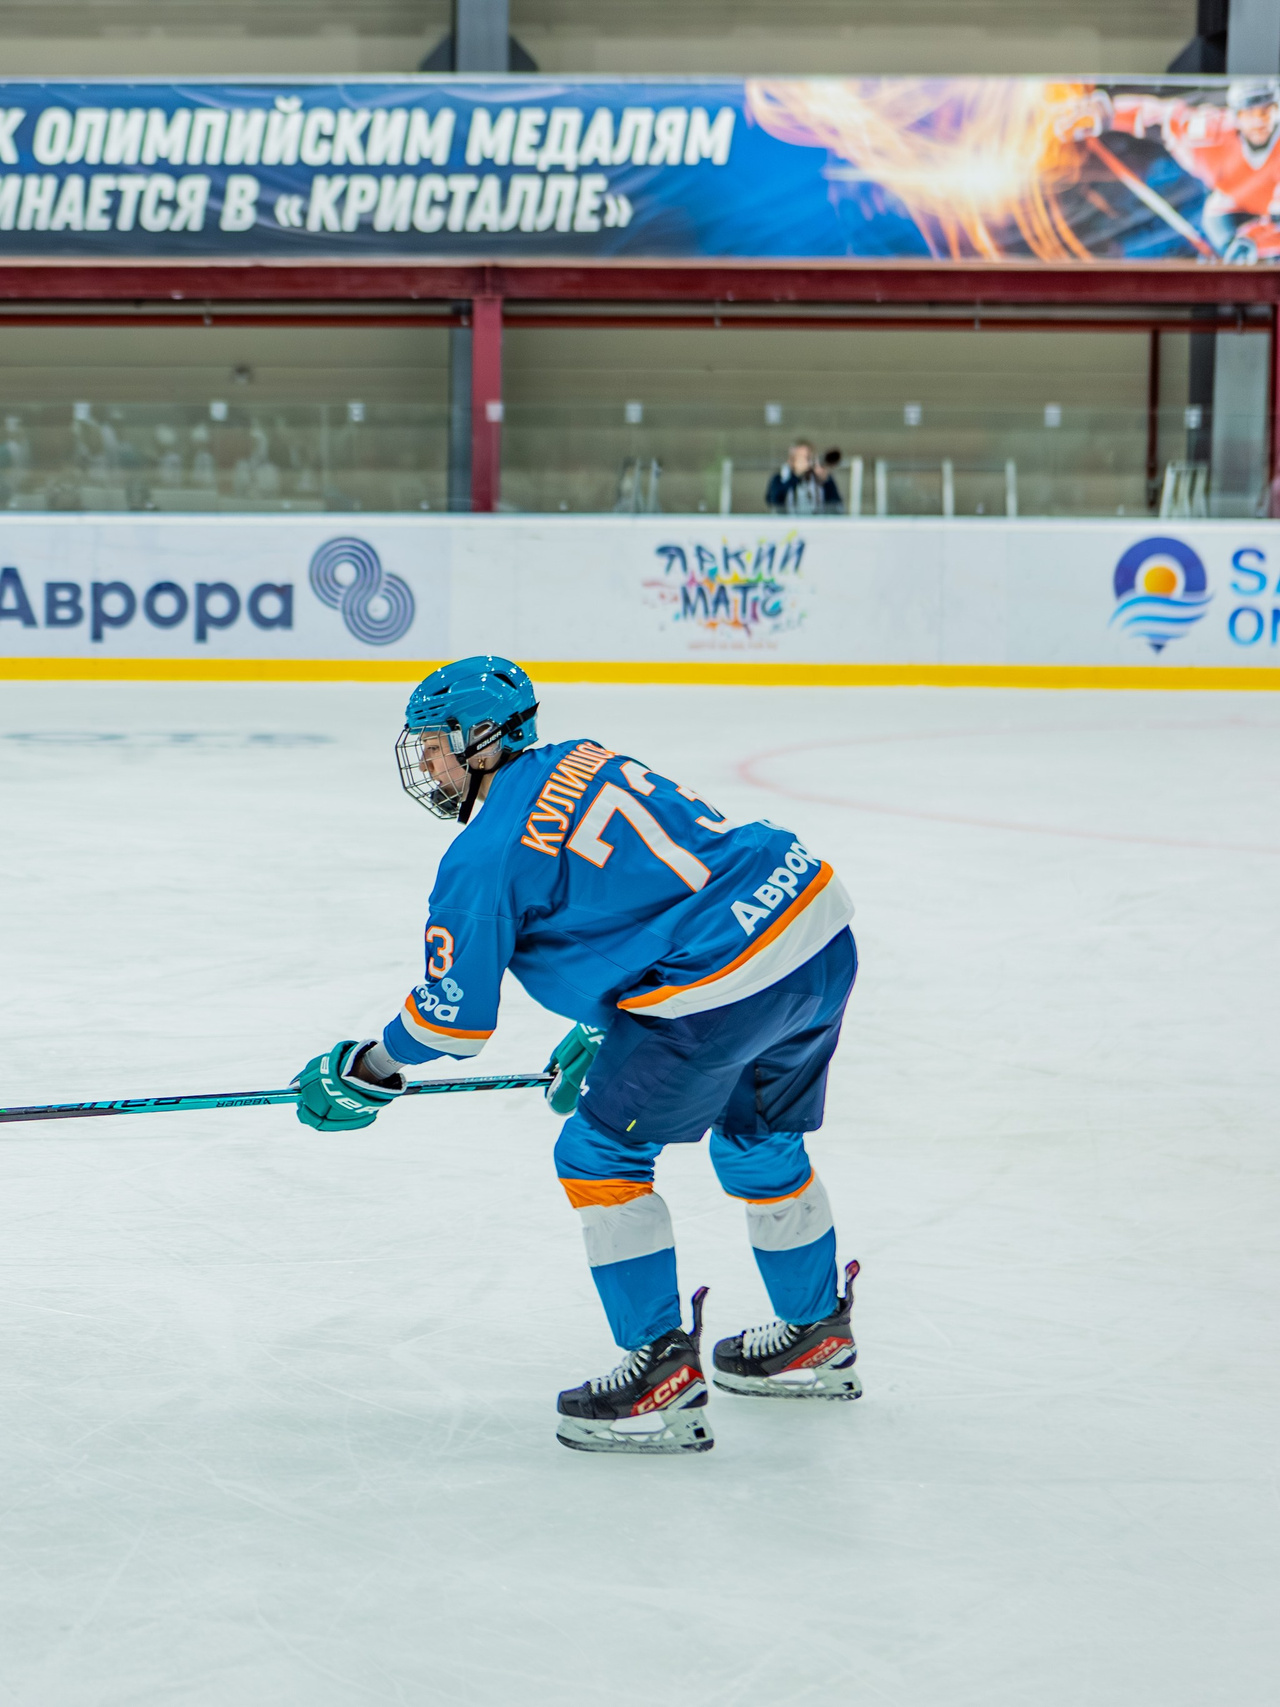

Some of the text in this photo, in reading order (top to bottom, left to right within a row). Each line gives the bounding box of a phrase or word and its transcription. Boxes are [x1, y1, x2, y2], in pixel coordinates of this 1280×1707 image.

[33, 95, 456, 167] ОЛИМПИЙСКИМ
[464, 106, 736, 172] МЕДАЛЯМ
[219, 173, 261, 232] В
[274, 173, 634, 233] «КРИСТАЛЛЕ»
[1231, 547, 1280, 598] S
[520, 741, 618, 857] КУЛИШО
[637, 1367, 690, 1415] CCM
